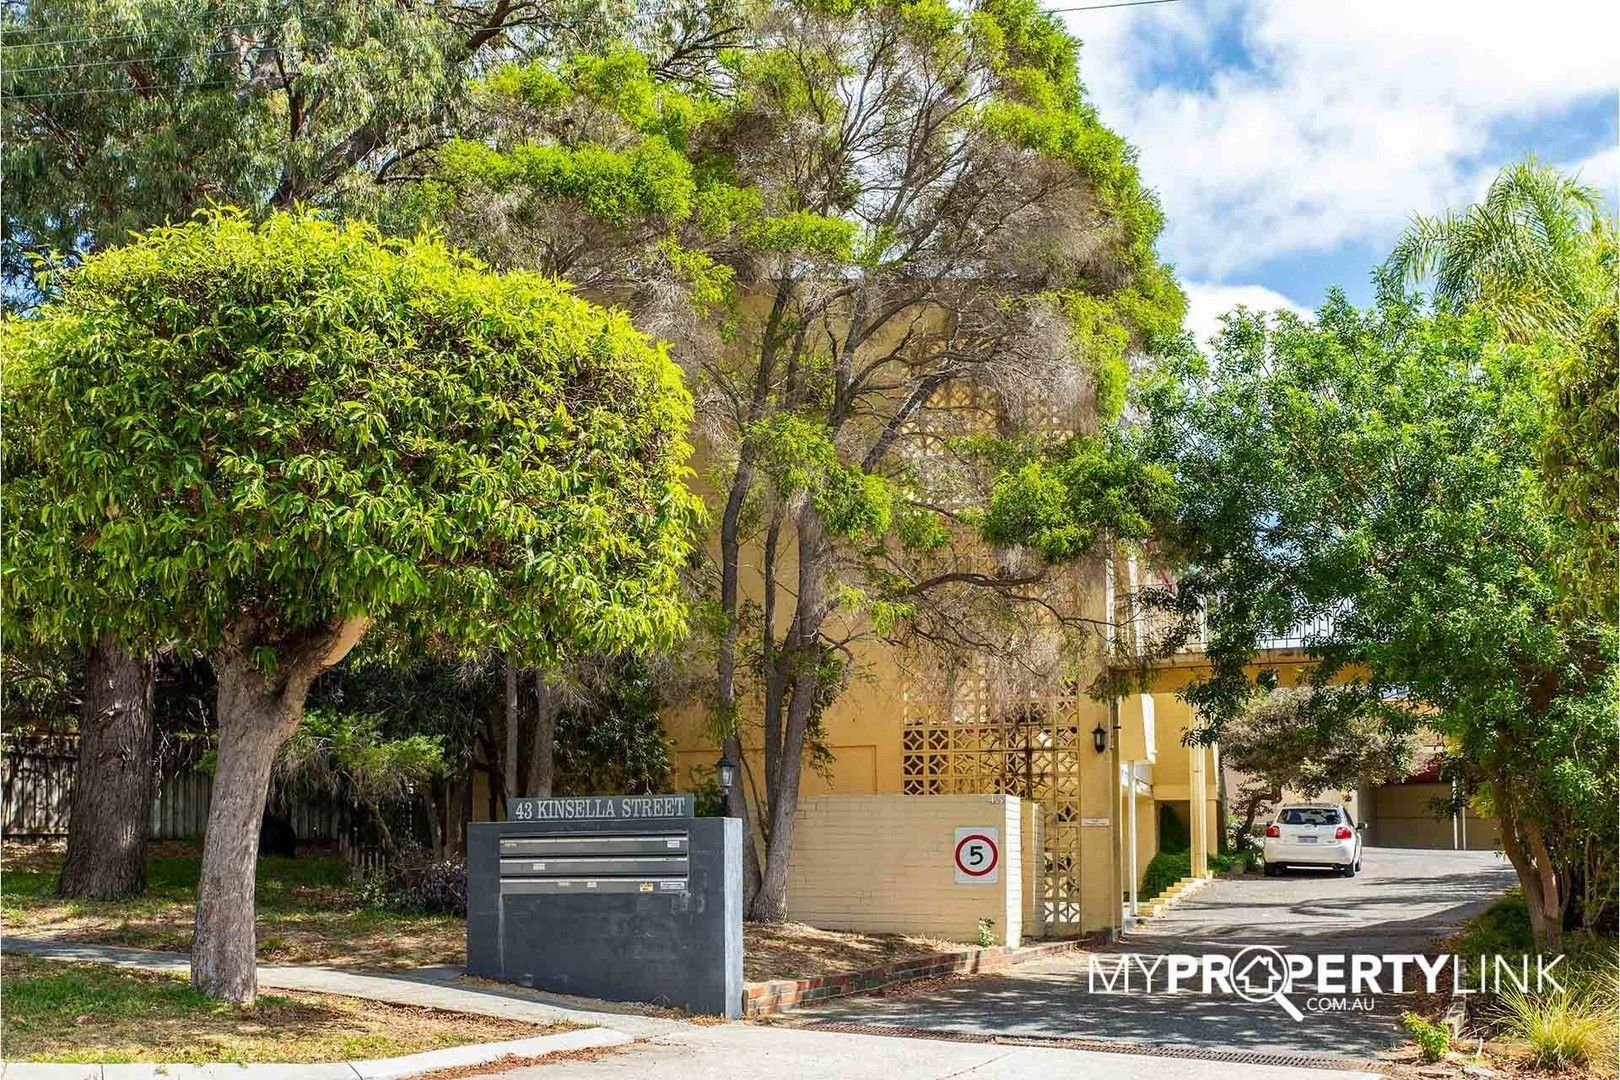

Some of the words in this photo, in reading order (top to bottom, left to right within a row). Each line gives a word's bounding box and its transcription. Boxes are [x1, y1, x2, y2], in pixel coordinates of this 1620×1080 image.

[515, 802, 533, 820] 43
[537, 799, 616, 819] KINSELLA
[621, 797, 685, 817] STREET
[969, 845, 984, 866] 5
